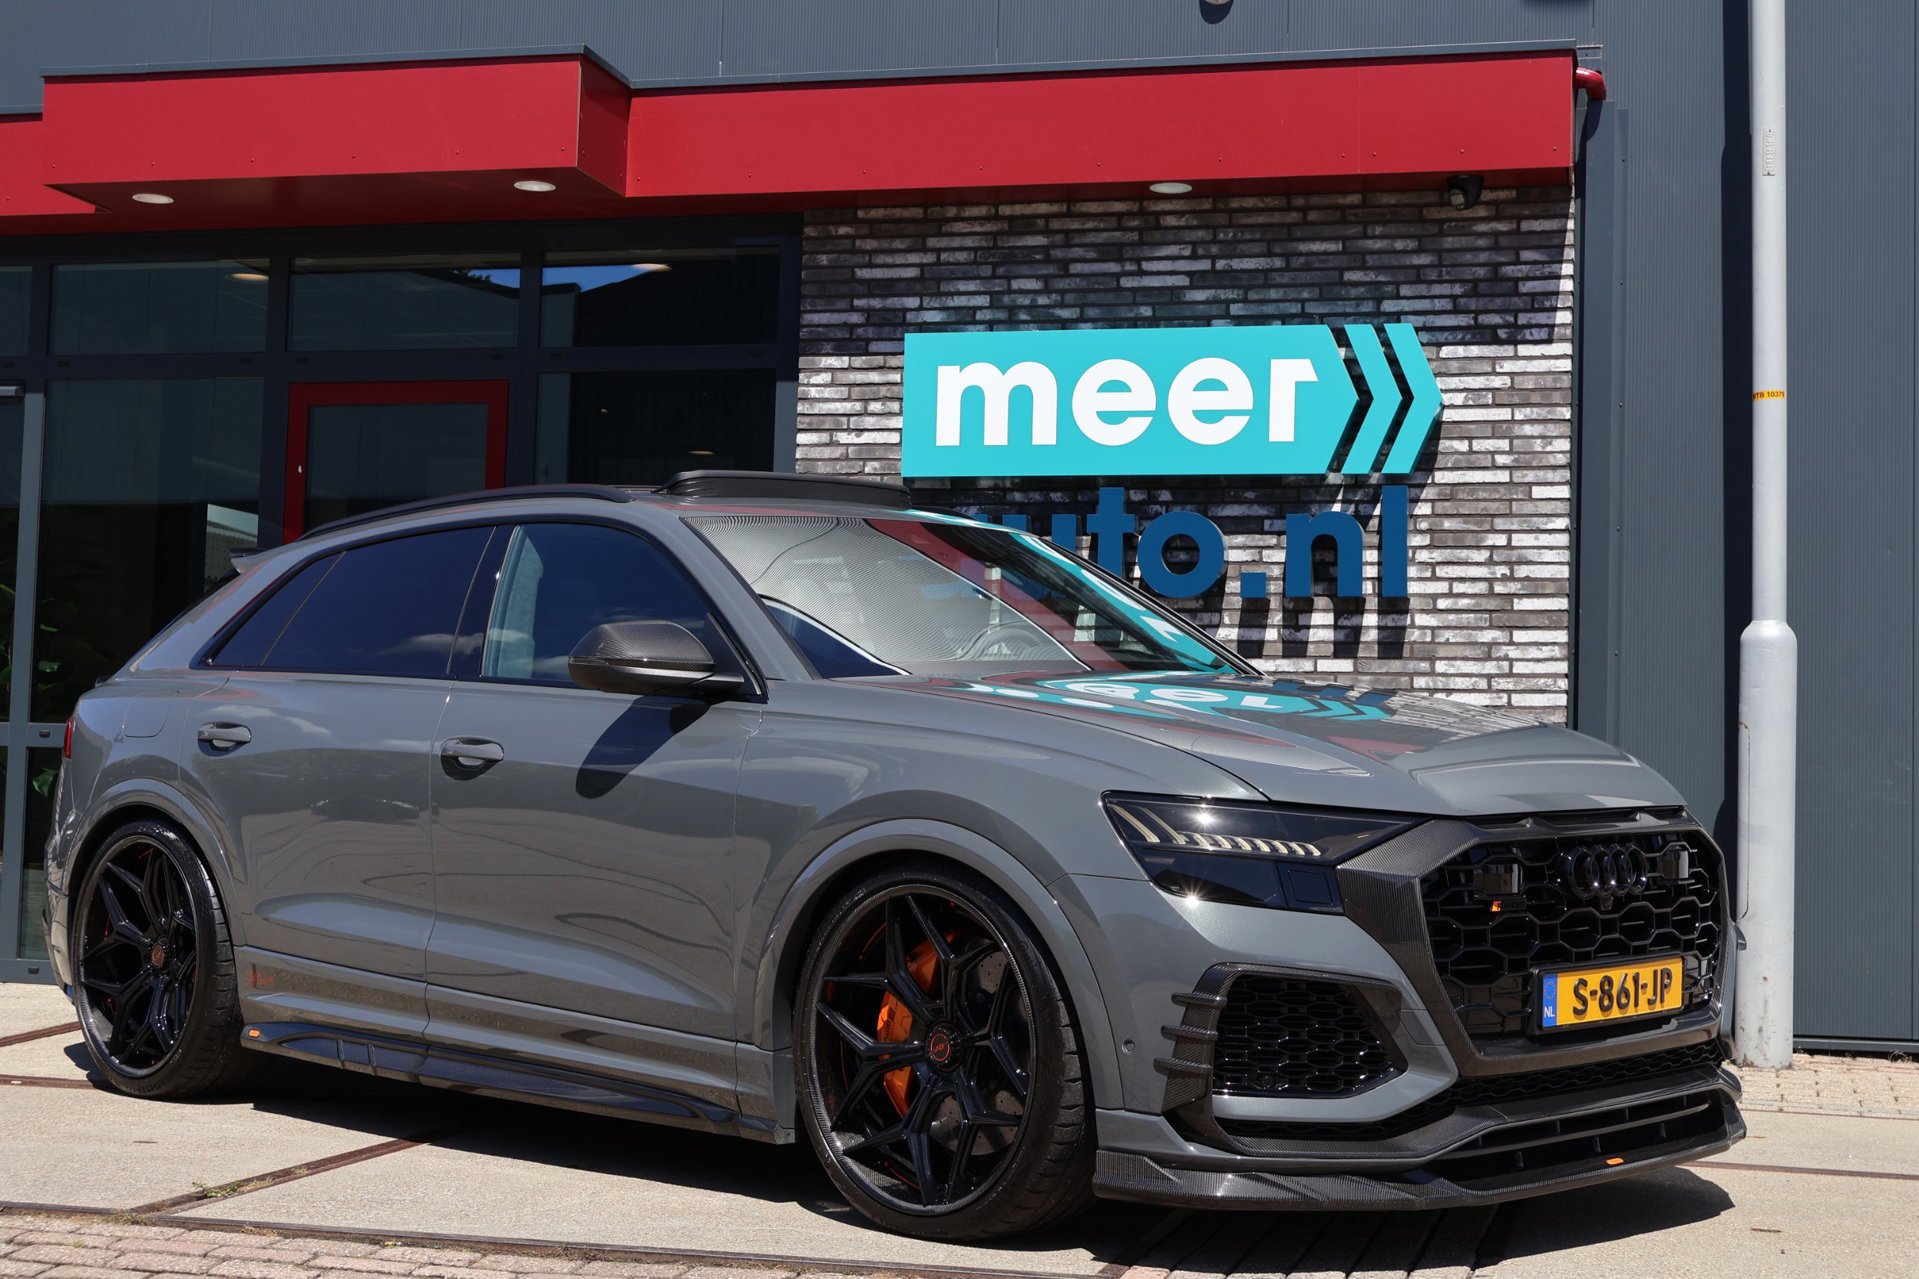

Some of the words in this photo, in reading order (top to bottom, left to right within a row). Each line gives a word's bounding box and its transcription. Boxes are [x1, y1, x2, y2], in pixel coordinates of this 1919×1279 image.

[936, 357, 1319, 446] meer
[976, 485, 1408, 598] to.nl
[1544, 1006, 1555, 1018] NL
[1573, 967, 1673, 1016] S-861-JP
